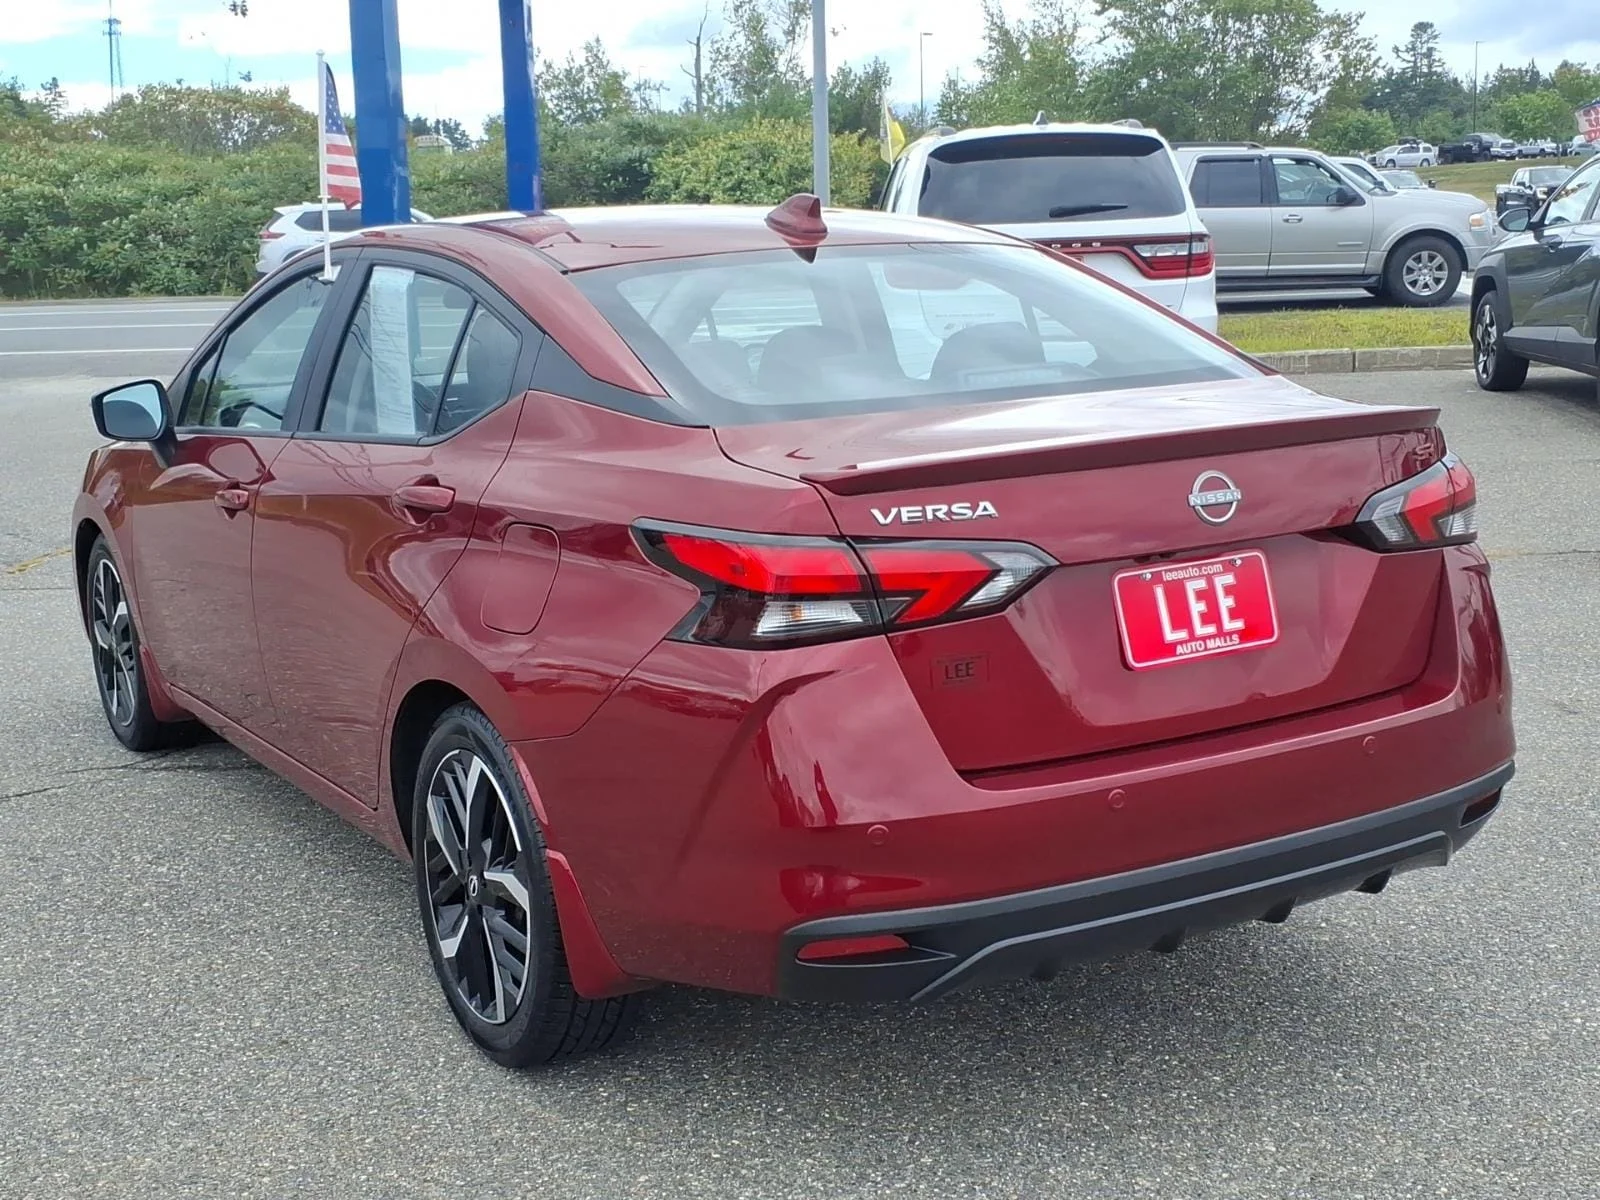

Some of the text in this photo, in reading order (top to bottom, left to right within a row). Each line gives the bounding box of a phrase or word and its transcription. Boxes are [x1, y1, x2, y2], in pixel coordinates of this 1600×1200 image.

[1190, 490, 1242, 505] NISSAN
[870, 500, 999, 525] VERSA
[1162, 564, 1223, 581] leeauto.com
[1153, 572, 1245, 643] LEE
[1176, 634, 1240, 655] AUTO MALLS
[945, 661, 975, 680] LEE
